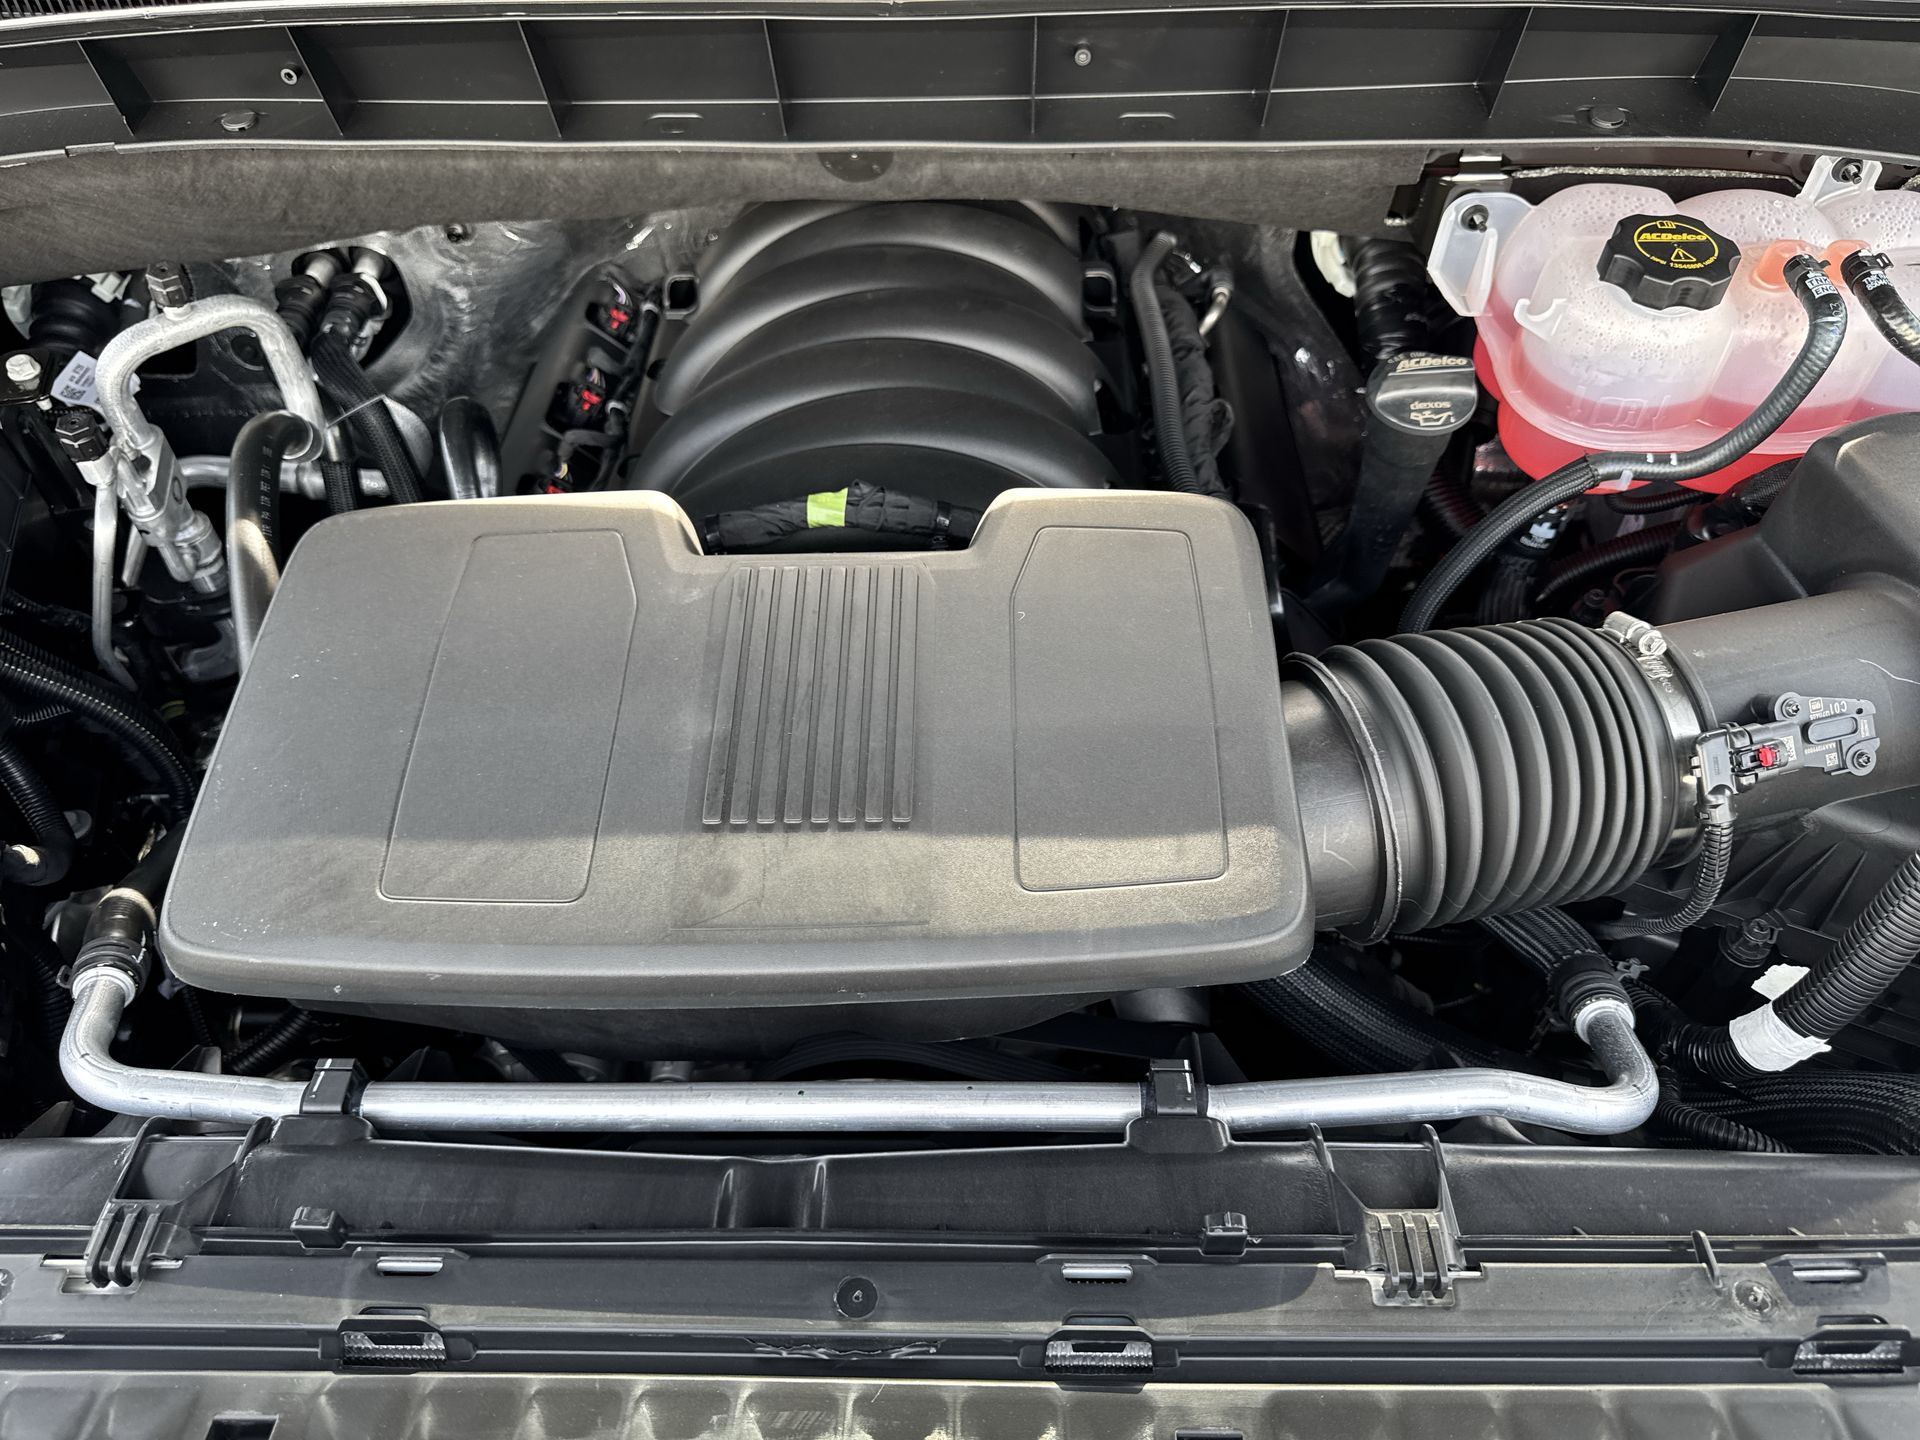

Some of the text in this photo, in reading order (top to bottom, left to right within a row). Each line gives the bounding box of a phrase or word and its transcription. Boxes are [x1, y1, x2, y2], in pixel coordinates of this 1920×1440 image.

[1638, 232, 1707, 241] ACDelco
[1396, 356, 1468, 370] ACDelco
[1409, 401, 1452, 411] dexos
[1829, 700, 1848, 715] C01
